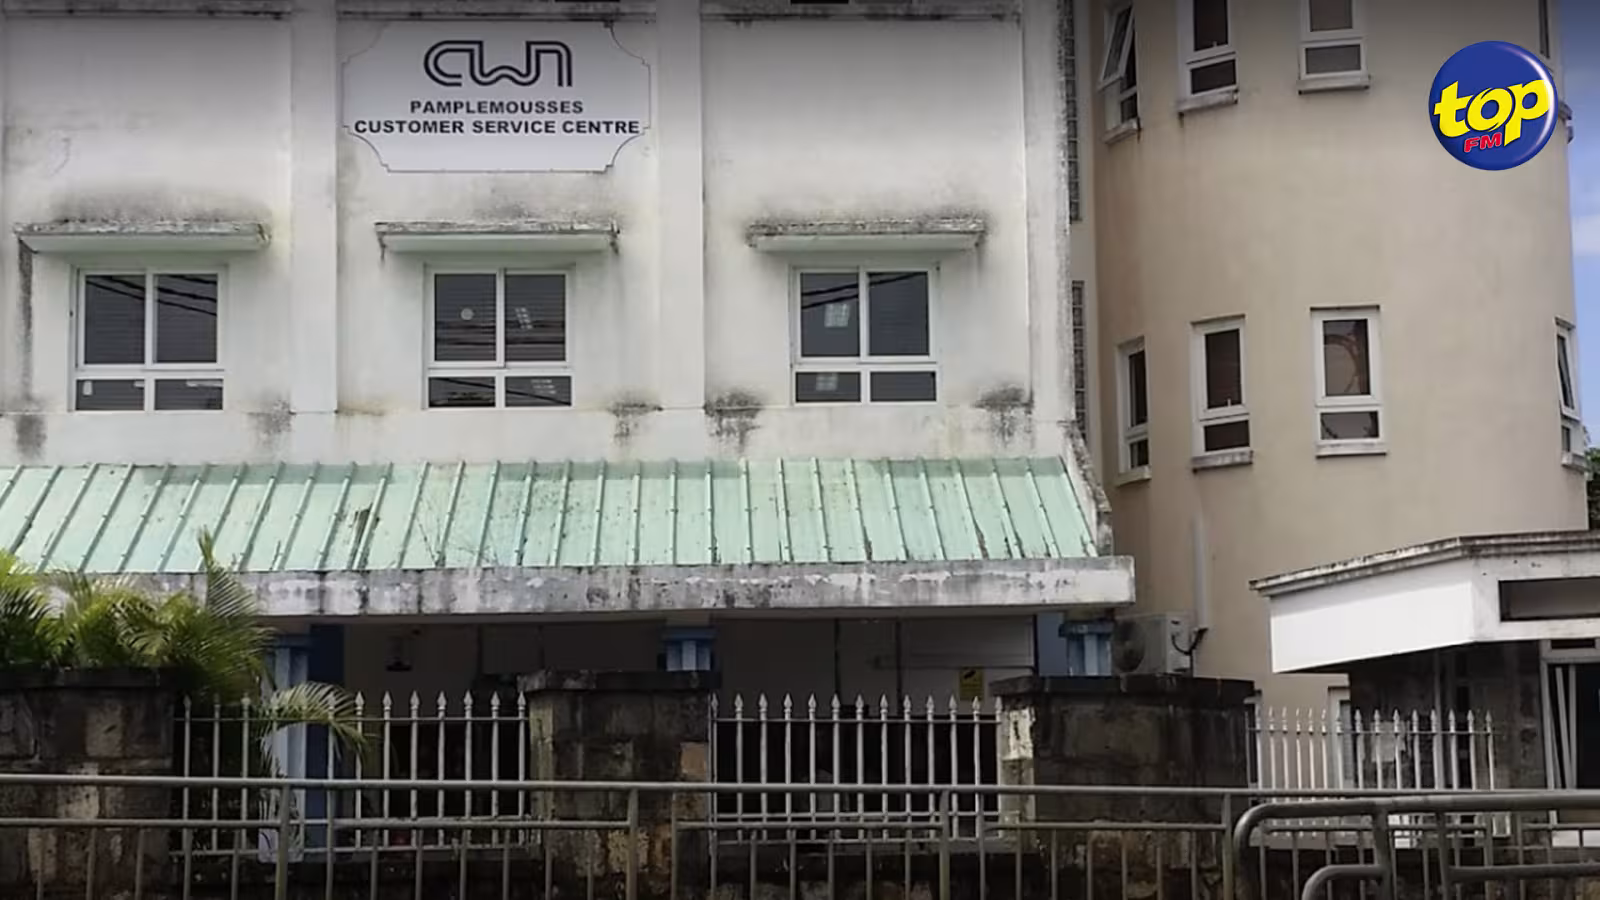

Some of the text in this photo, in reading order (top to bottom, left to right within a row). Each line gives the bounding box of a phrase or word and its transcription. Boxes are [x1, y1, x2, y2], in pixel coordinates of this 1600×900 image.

[410, 100, 584, 114] PAMPLEMOUSSES
[354, 120, 640, 134] CUSTOMER SERVICE CENTRE
